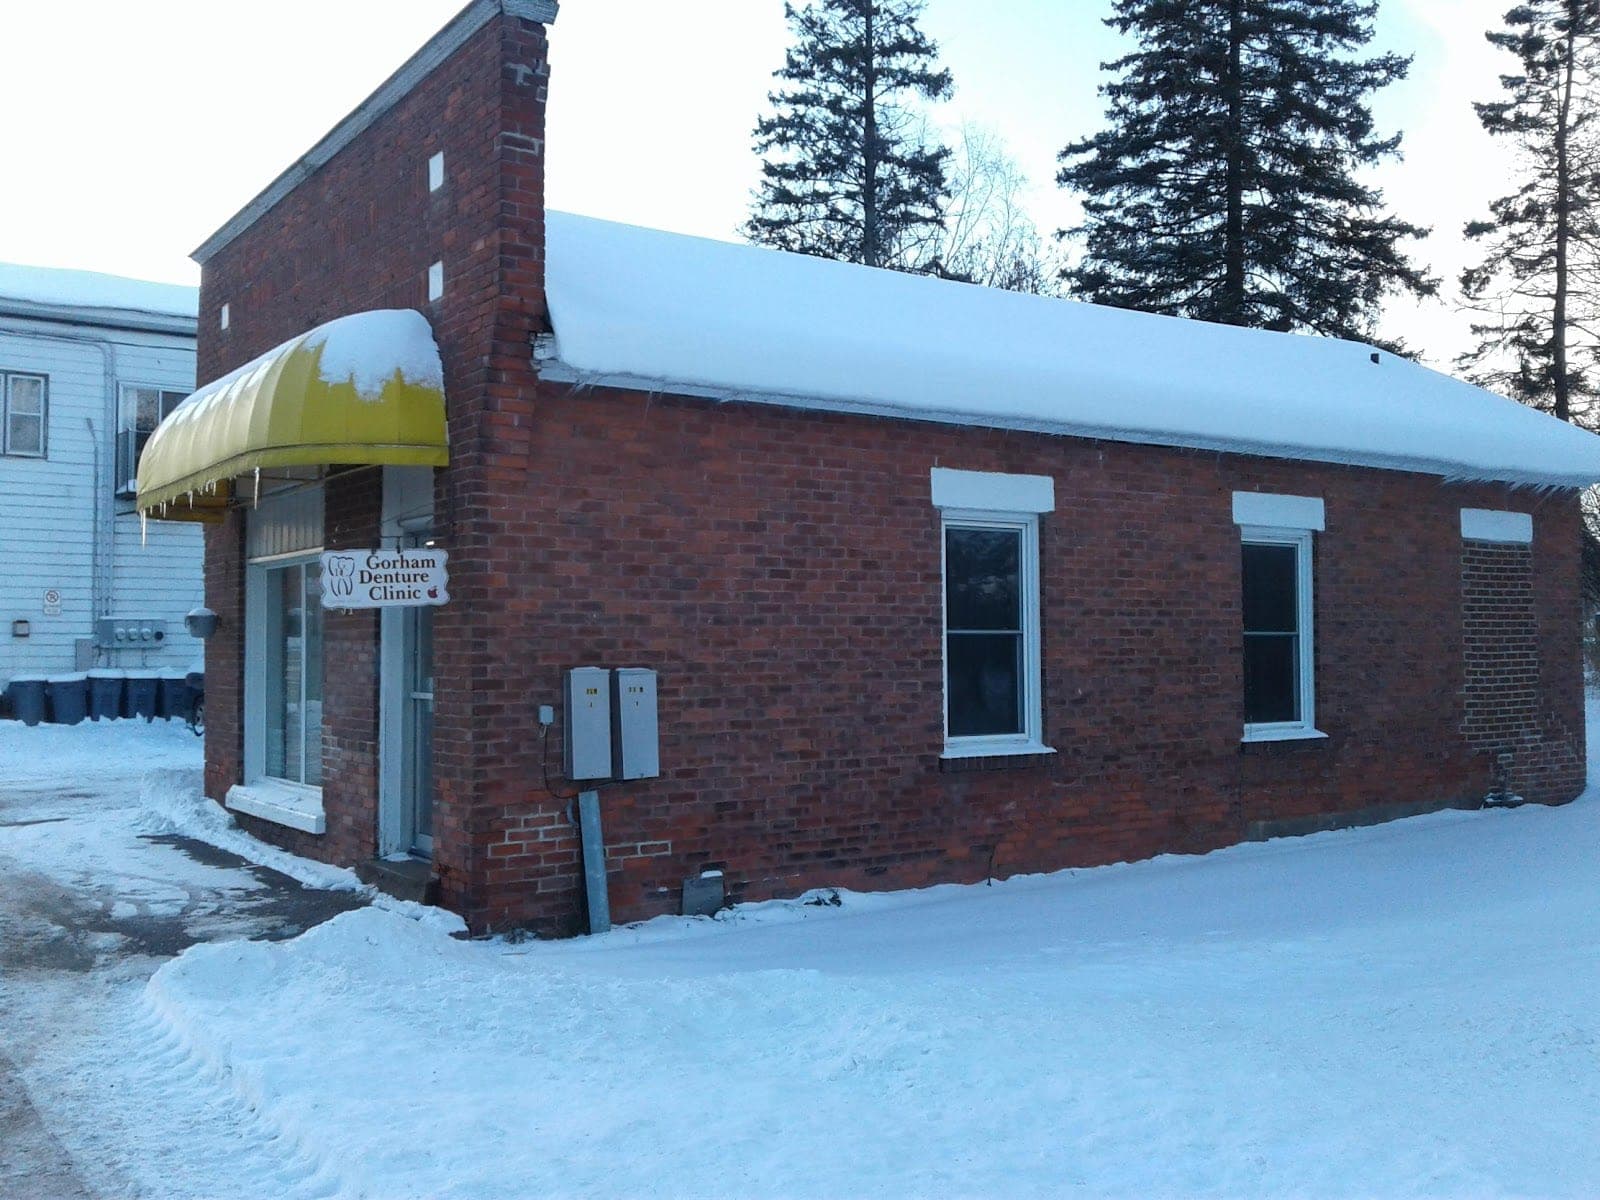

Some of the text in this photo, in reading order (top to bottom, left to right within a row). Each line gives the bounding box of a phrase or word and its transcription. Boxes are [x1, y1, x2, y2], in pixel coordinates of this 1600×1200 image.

[366, 554, 437, 570] Gorham
[358, 570, 430, 584] Denture
[368, 585, 422, 601] Clinic
